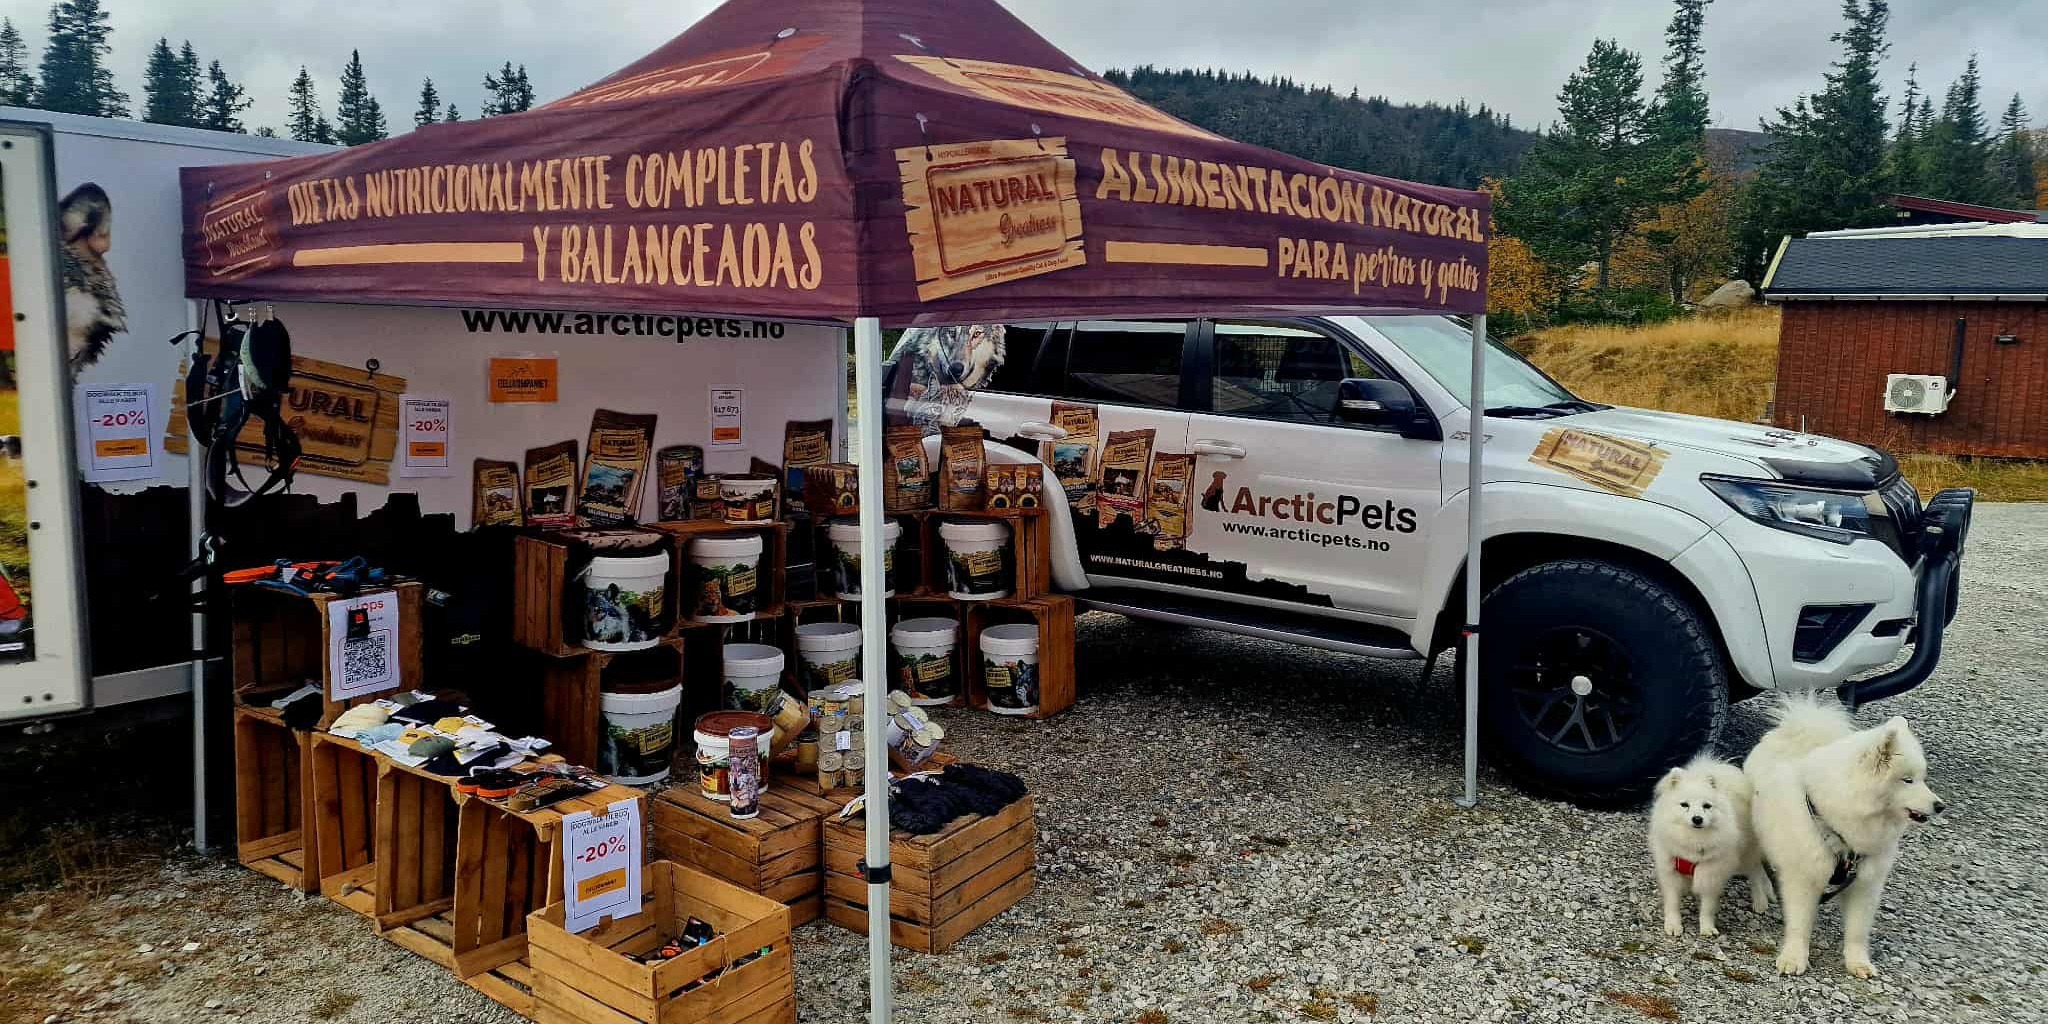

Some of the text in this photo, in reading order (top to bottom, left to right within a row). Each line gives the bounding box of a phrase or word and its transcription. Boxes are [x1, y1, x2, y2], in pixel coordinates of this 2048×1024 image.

[288, 138, 818, 226] DIETAS NUTRICIONALMENTE COMPLETAS
[936, 173, 1056, 215] NATURAL
[1096, 147, 1484, 243] ALIMENTACIÓN NATURAL
[205, 203, 263, 243] NATURAL
[999, 212, 1057, 248] Greatness
[532, 221, 823, 291] Y BALANCEADAS
[1278, 237, 1481, 305] PARA perros y gatos
[461, 310, 785, 343] www.arcticpets.no
[92, 410, 146, 427] -20%
[409, 418, 445, 432] -20%
[1564, 431, 1641, 471] NATURAL
[1230, 486, 1417, 534] ArcticPets
[1222, 521, 1390, 552] www.arcticpets.no
[1090, 554, 1224, 579] WWW.NATURALGREATNESS.NO
[576, 834, 626, 863] -20%
